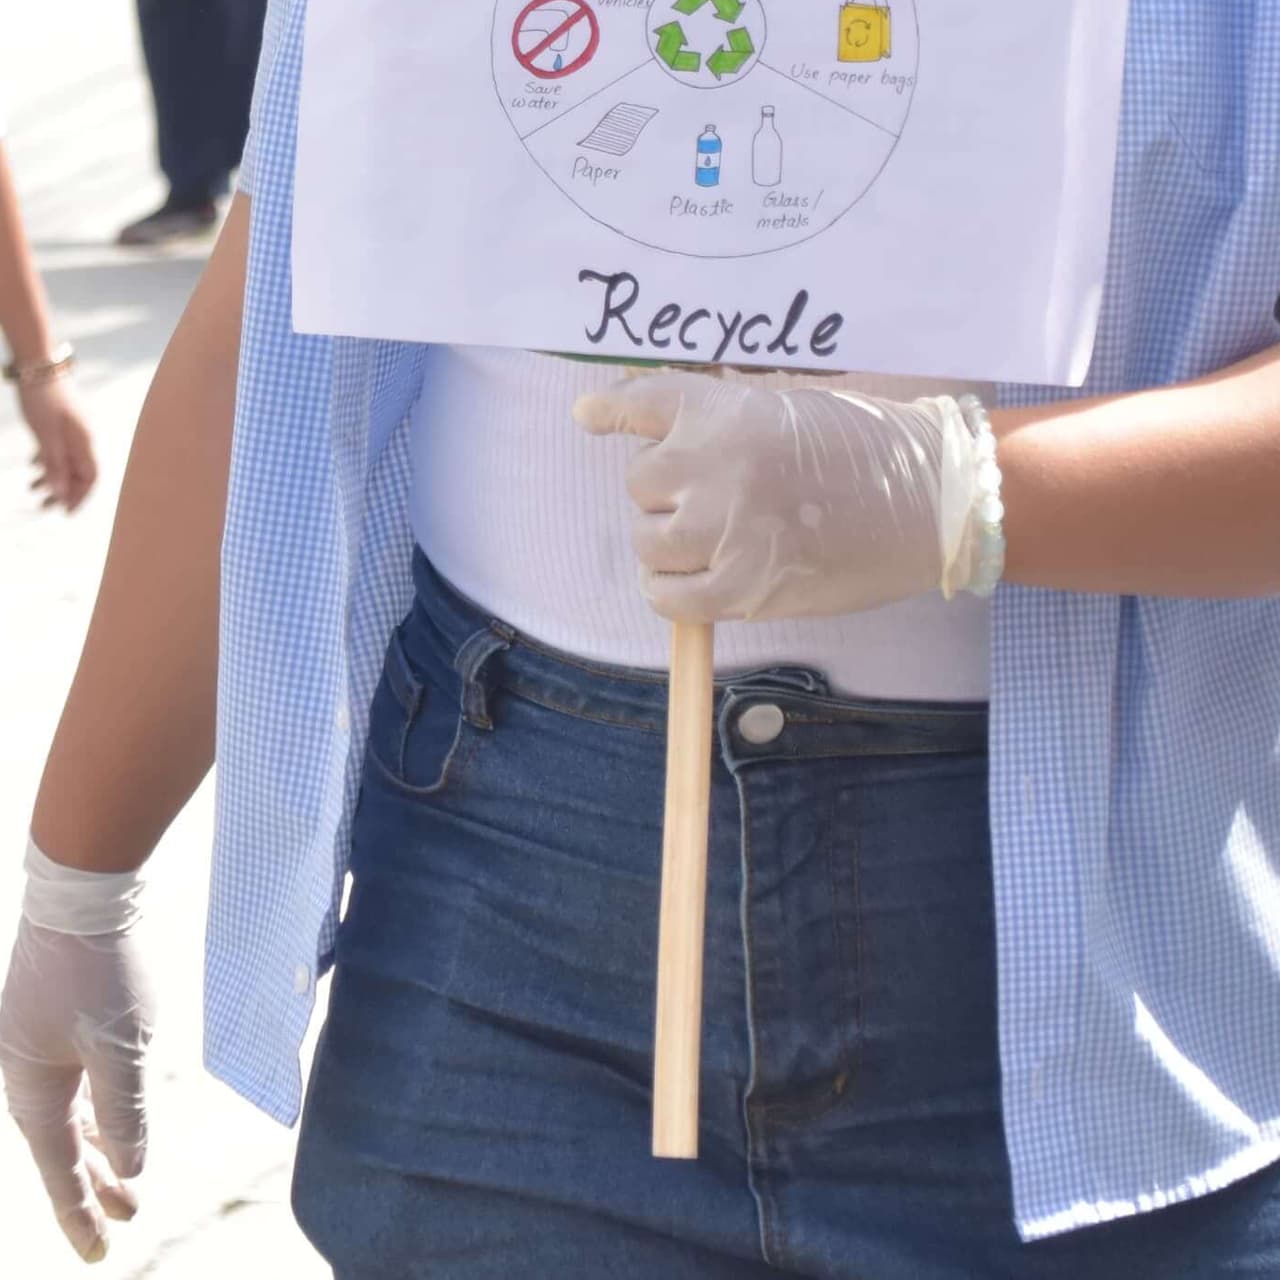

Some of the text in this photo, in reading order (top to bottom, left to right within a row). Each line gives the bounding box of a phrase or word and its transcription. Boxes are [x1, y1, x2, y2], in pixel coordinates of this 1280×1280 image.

[524, 81, 562, 96] Save
[791, 63, 915, 94] Use paper bags
[512, 96, 559, 110] water
[571, 156, 621, 186] Paper
[670, 195, 733, 216] Plastic
[757, 213, 809, 230] metals
[579, 269, 843, 361] Recycle
